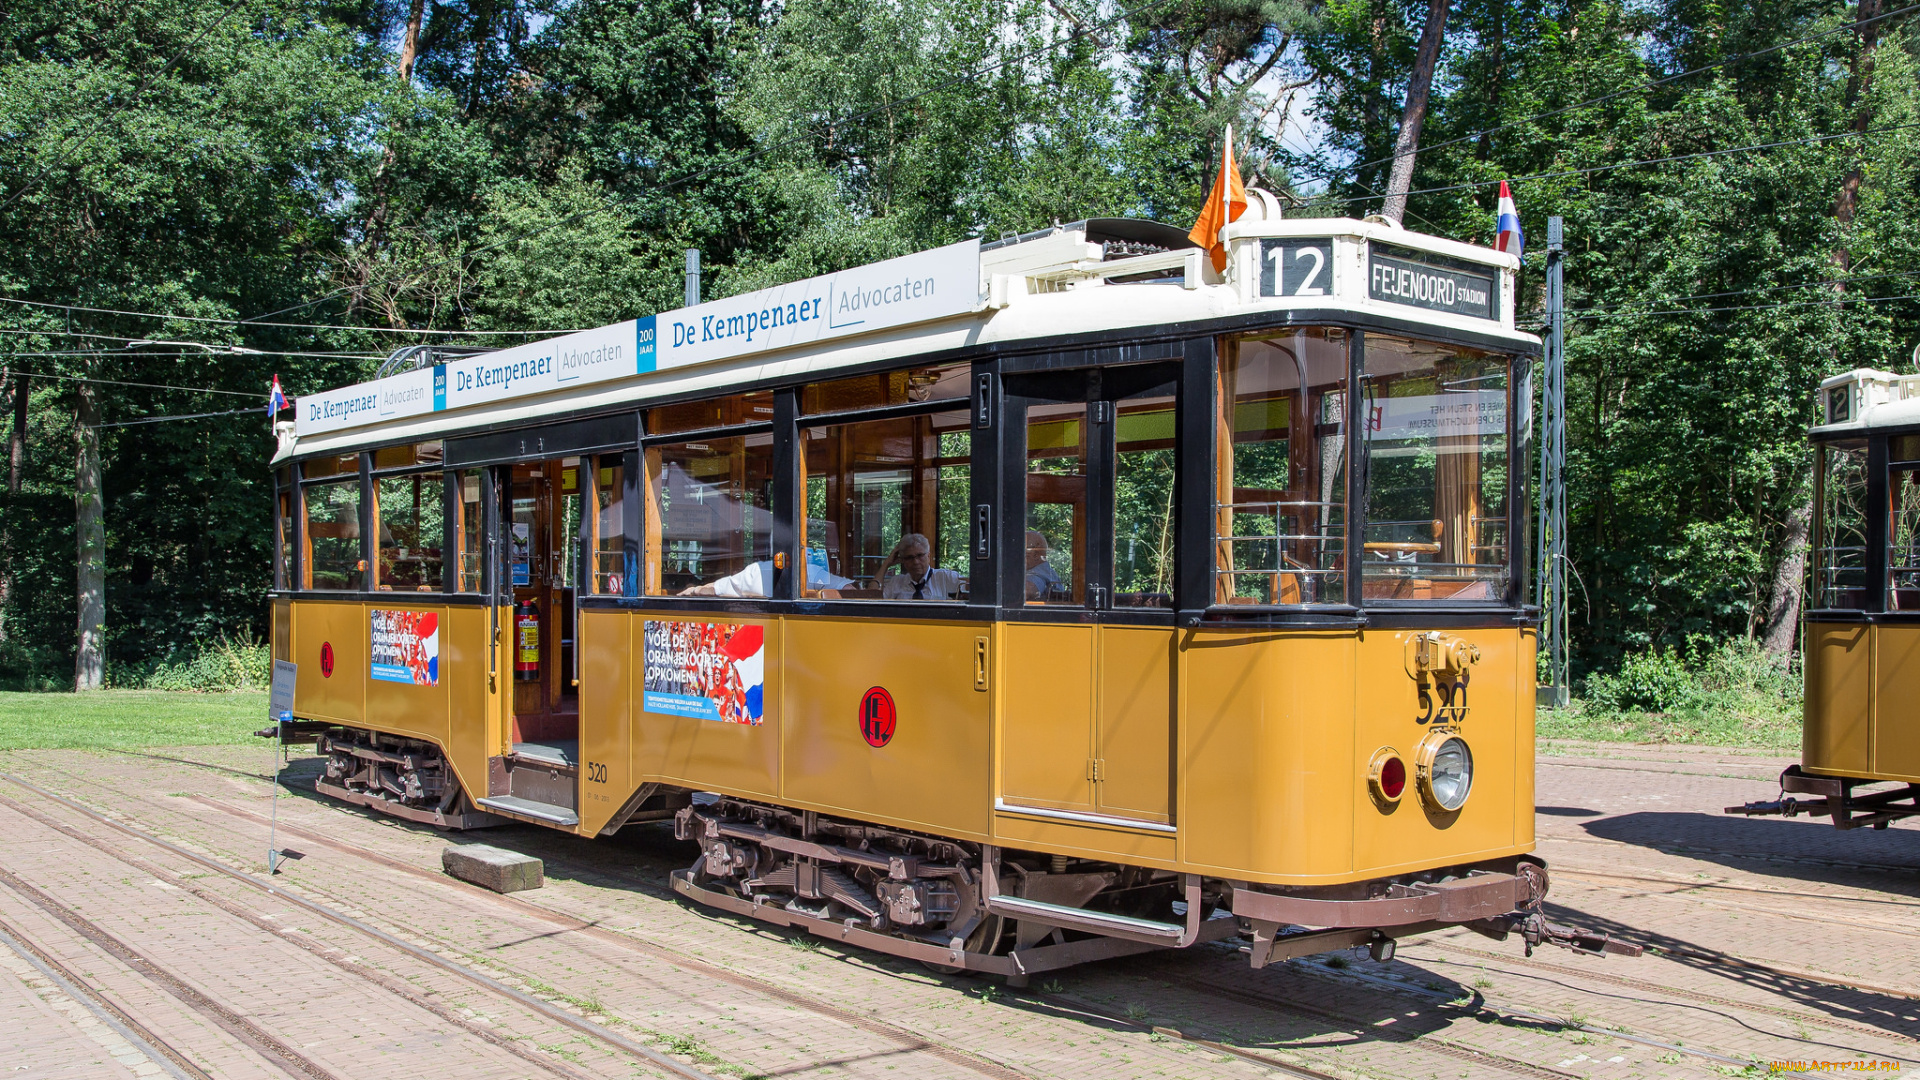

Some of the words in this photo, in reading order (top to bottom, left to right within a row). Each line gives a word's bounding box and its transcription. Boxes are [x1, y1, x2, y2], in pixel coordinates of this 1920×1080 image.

[1267, 246, 1326, 296] 12
[1457, 287, 1486, 307] STADION
[672, 321, 696, 348] De
[701, 296, 823, 343] Kempenaer
[838, 276, 935, 314] Advocaten
[639, 327, 654, 343] 200
[639, 343, 654, 355] JAAR
[456, 369, 473, 392] De
[475, 354, 552, 389] Kempenaer
[562, 342, 623, 370] Advocaten
[434, 373, 446, 388] 200
[309, 402, 322, 422] De
[323, 393, 377, 420] Kempenaer
[383, 385, 424, 408] Advocaten
[647, 633, 671, 648] VOEL
[673, 634, 686, 648] DE
[647, 650, 723, 669] ORANJEKOORTS
[647, 667, 692, 684] OPKOMEN
[1415, 682, 1467, 725] 520
[588, 761, 608, 784] 520
